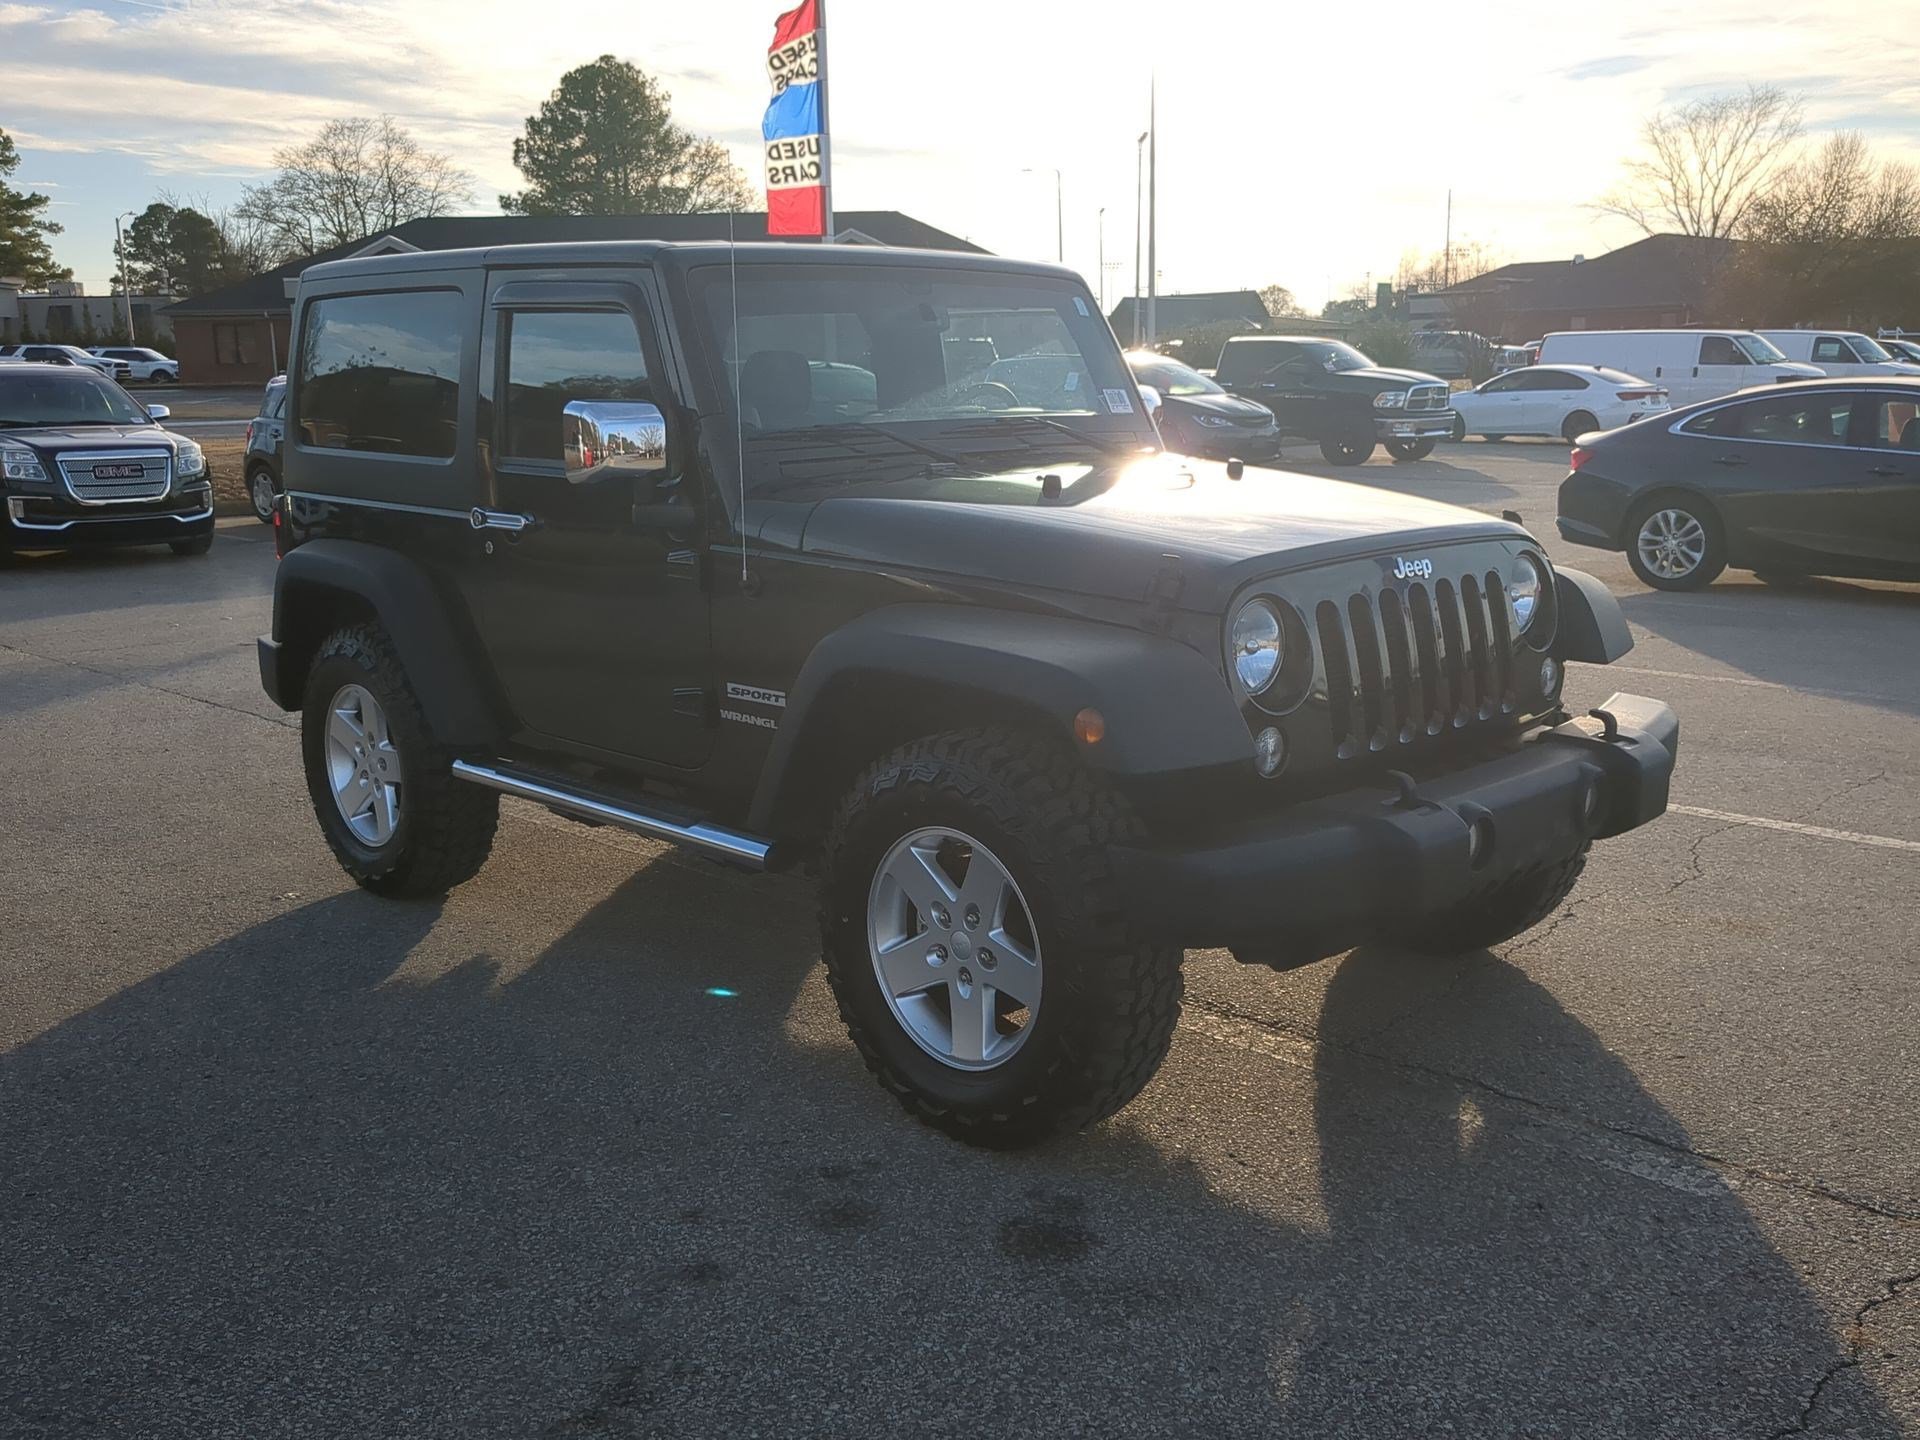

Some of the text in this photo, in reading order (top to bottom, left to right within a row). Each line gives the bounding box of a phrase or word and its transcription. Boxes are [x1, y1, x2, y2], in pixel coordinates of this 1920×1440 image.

[95, 465, 142, 478] GMC
[1393, 556, 1432, 579] Jeep
[729, 687, 784, 703] SPORT
[720, 709, 778, 729] WRANGL
